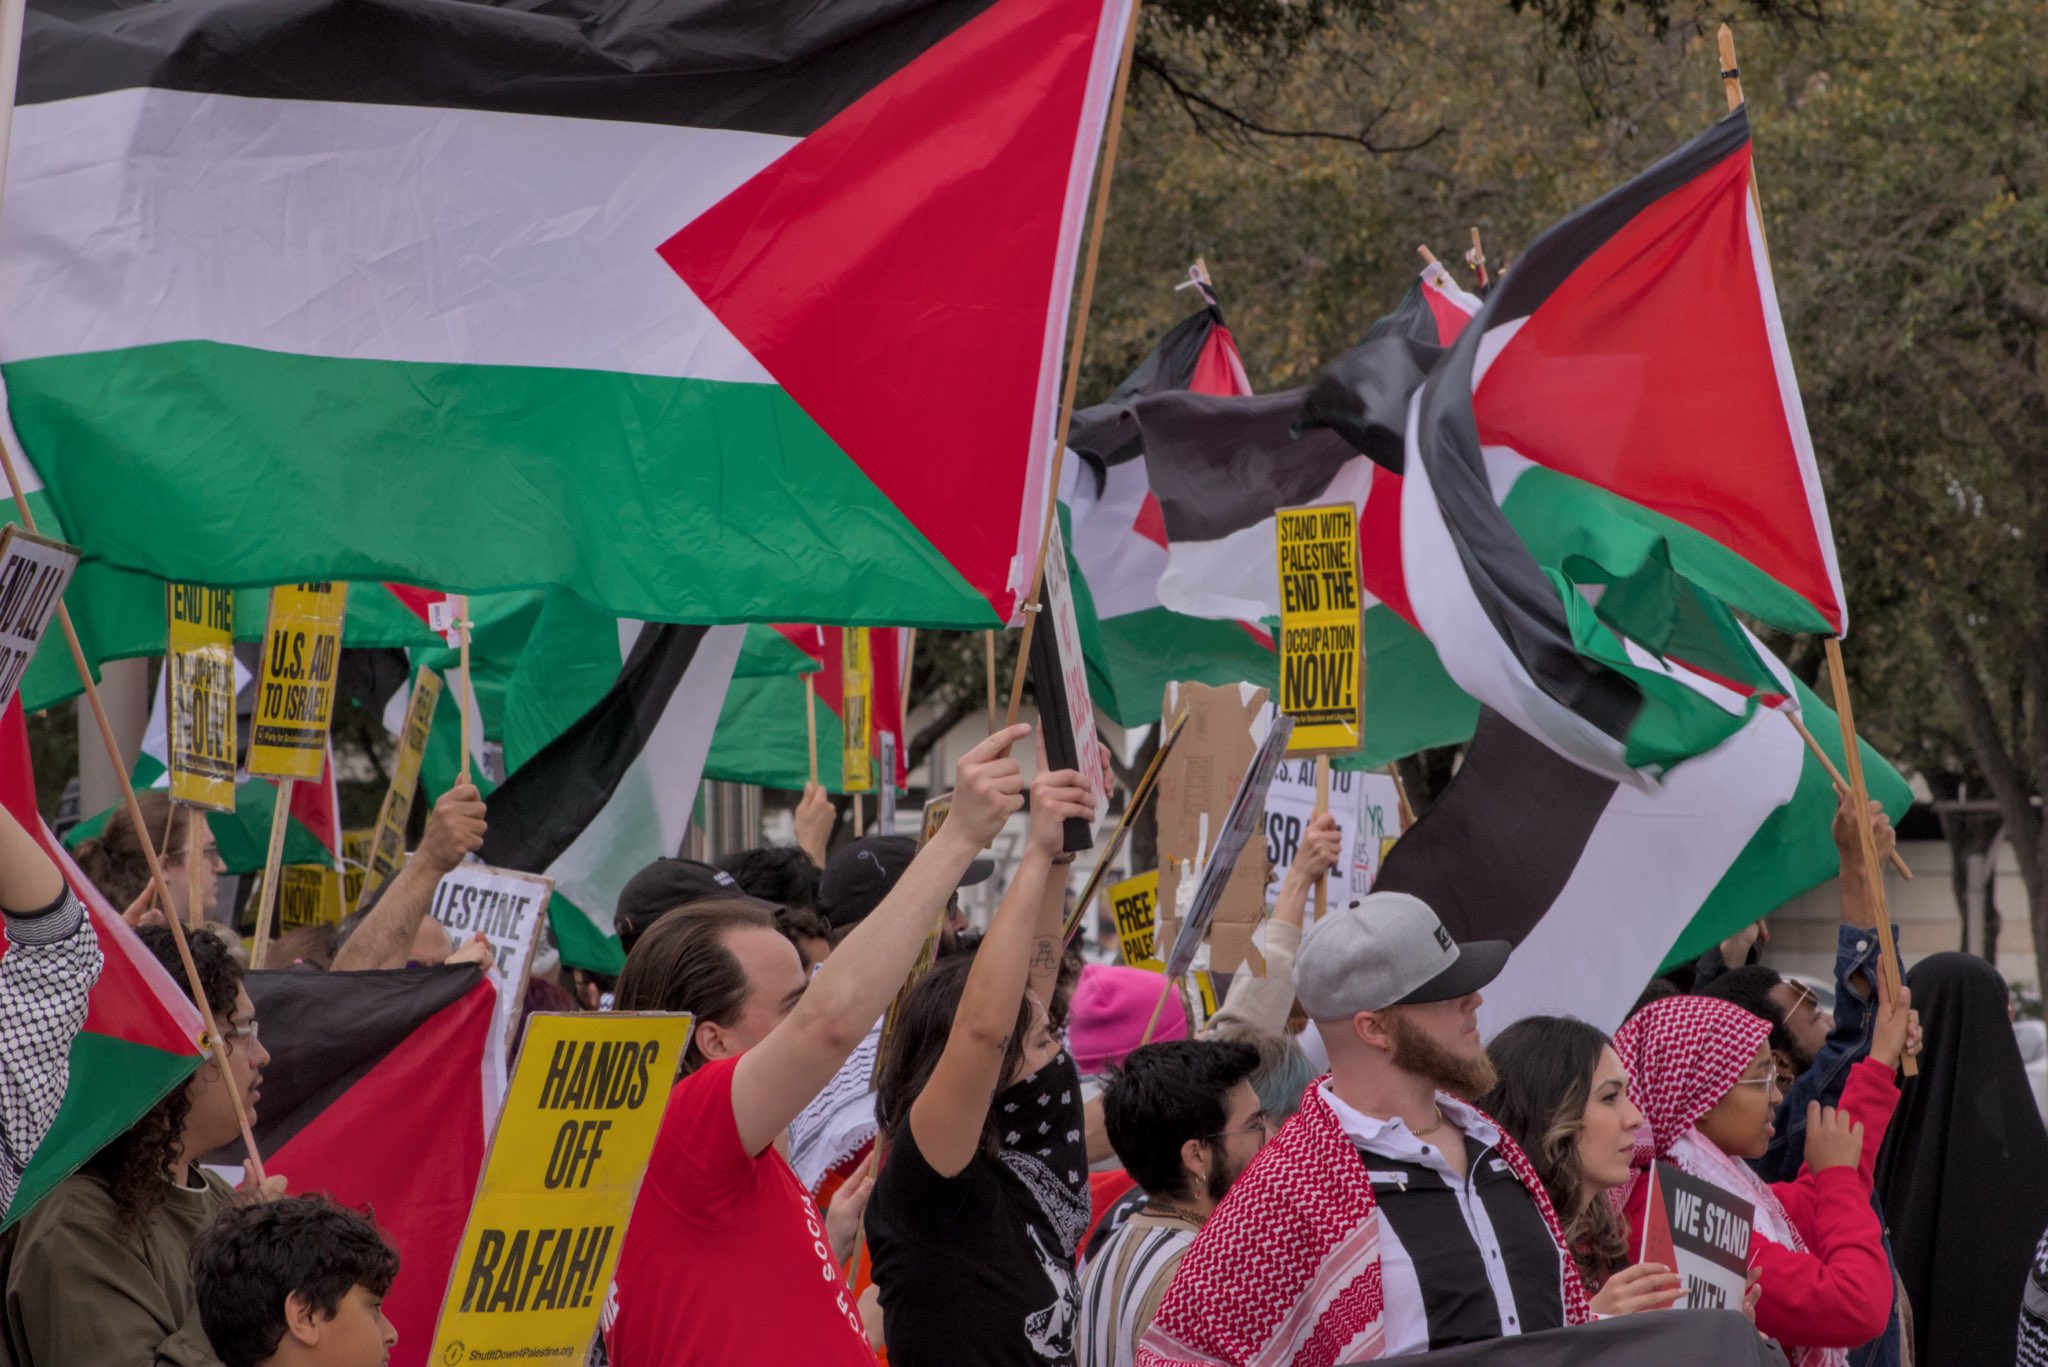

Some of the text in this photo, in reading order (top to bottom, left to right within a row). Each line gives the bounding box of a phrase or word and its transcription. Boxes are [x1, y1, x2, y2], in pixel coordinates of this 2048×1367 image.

[1281, 512, 1351, 542] STAND WITH
[1281, 540, 1351, 573] PALESTINE!
[12, 565, 65, 642] ALL
[174, 584, 232, 633] END THE
[1283, 570, 1356, 613] END THE
[271, 630, 335, 682] U.S. AID
[1285, 624, 1355, 654] OCCUPATION
[264, 682, 331, 723] TO ISRAEL!
[1284, 652, 1353, 710] NOW!
[1297, 761, 1317, 788] AI
[1115, 890, 1155, 936] FREE
[537, 1039, 660, 1111] HANDS
[544, 1119, 613, 1190] OFF
[1674, 1188, 1703, 1237] WE
[1703, 1202, 1750, 1261] STAND
[459, 1225, 615, 1313] RAFAH!
[1687, 1273, 1727, 1310] WITH
